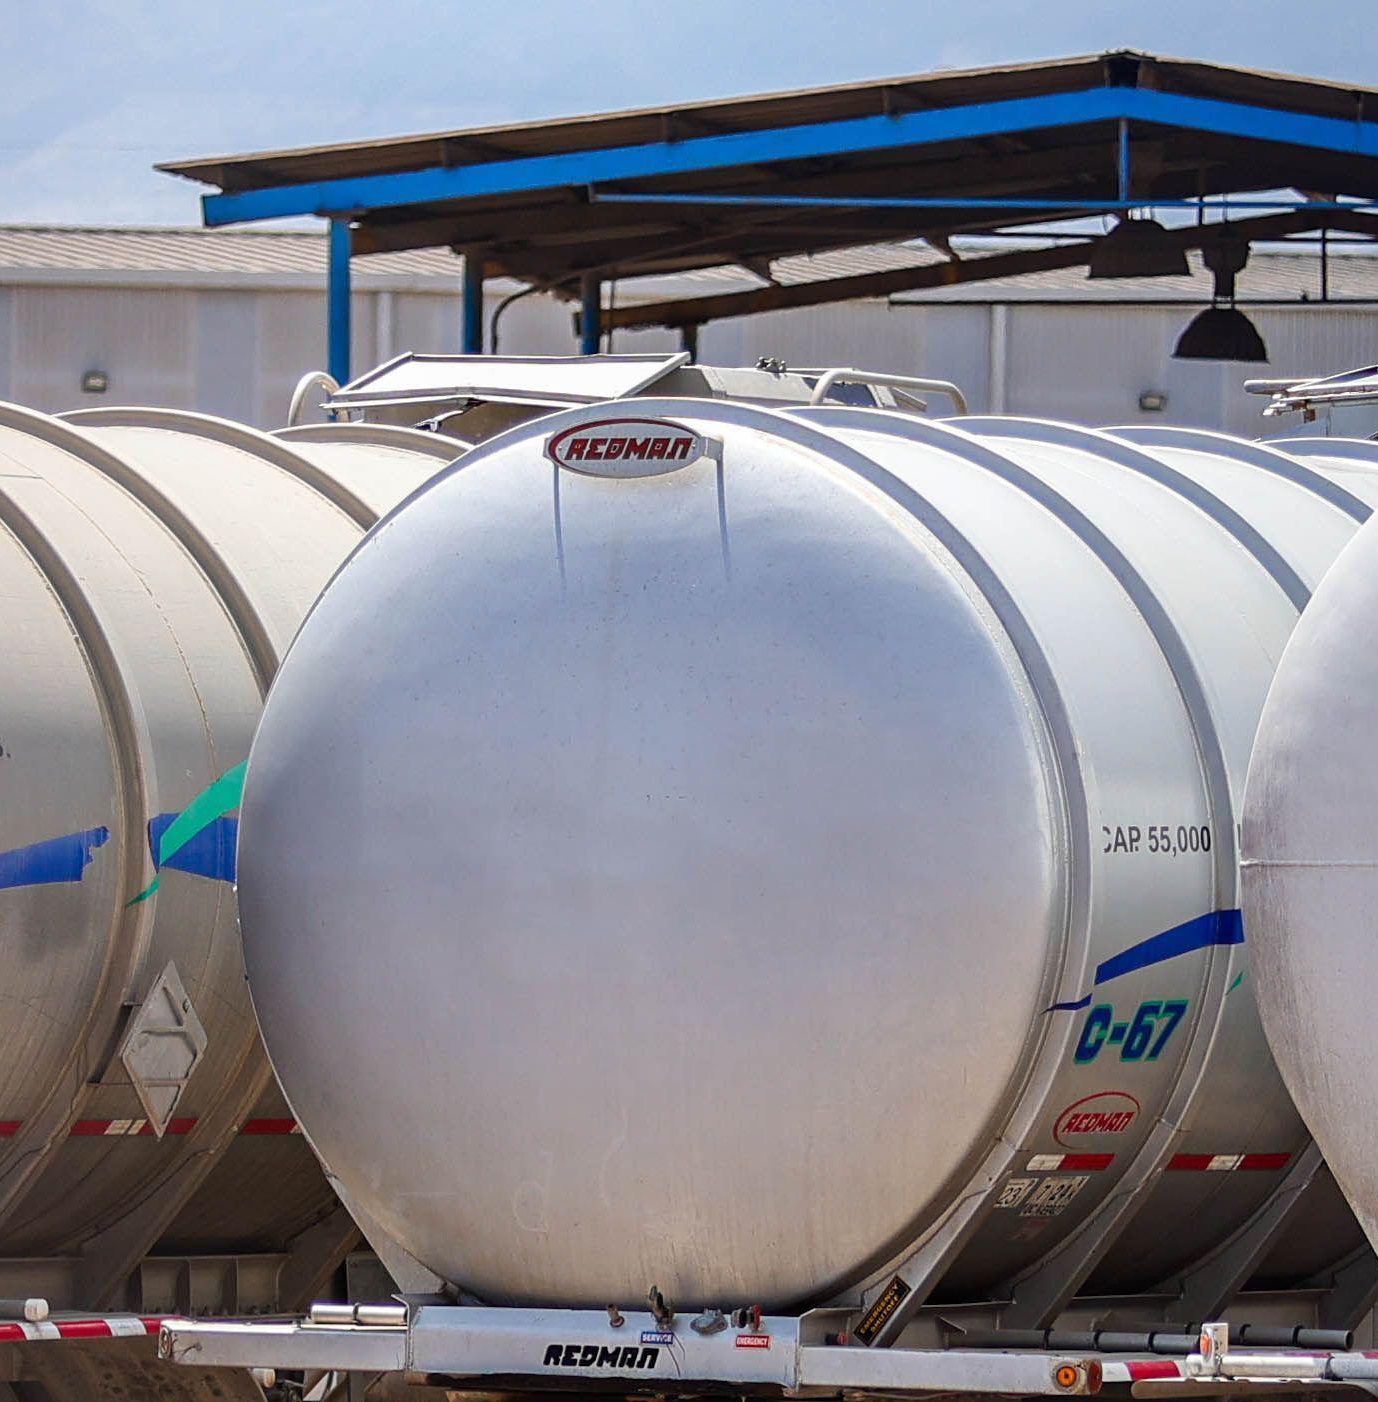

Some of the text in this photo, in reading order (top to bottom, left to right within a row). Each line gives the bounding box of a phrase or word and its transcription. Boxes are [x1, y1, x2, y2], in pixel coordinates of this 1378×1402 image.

[564, 437, 694, 461] REDMAN
[1147, 825, 1211, 858] 55,000
[1072, 999, 1190, 1066] C-67
[1061, 1111, 1136, 1134] REDMAN
[543, 1344, 660, 1369] REDMAN
